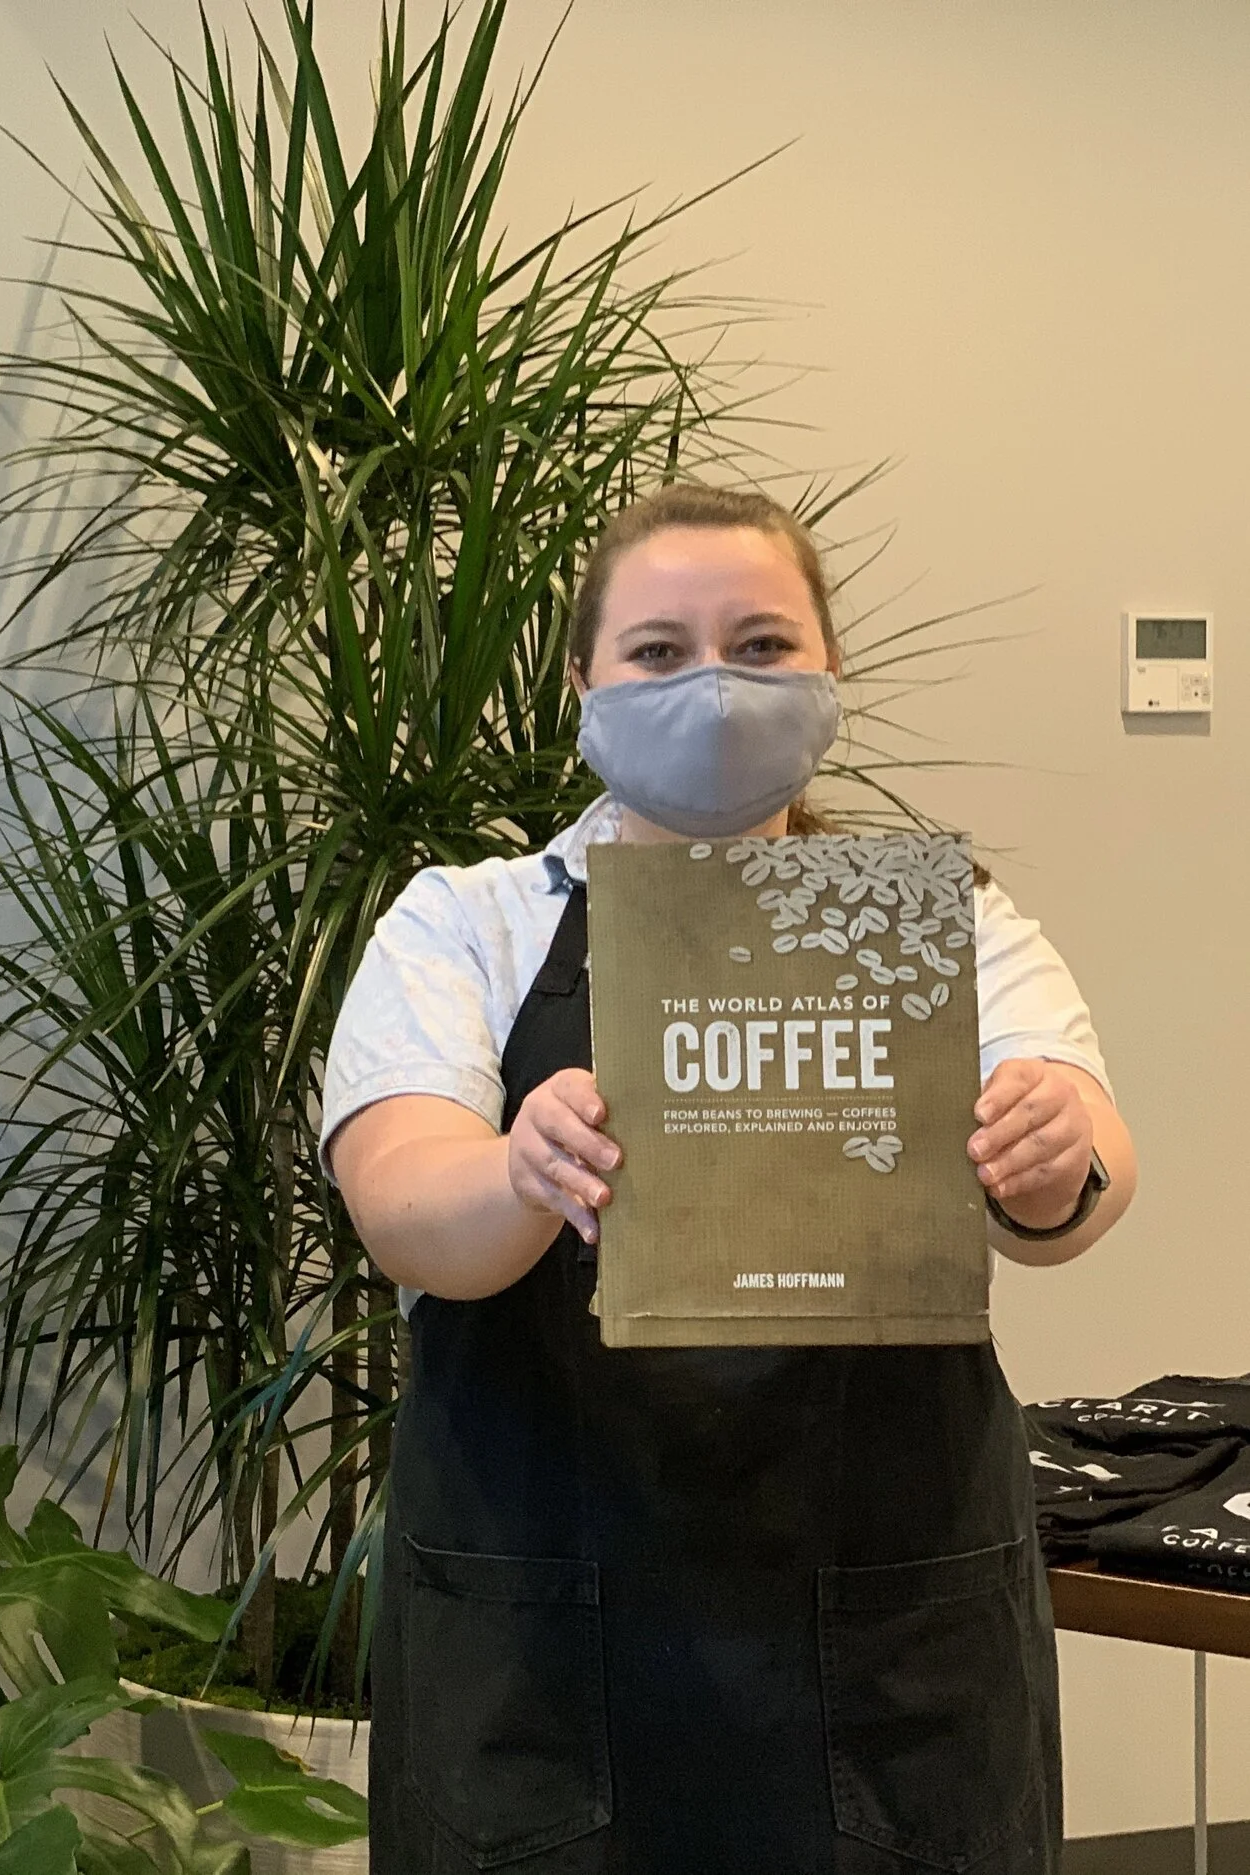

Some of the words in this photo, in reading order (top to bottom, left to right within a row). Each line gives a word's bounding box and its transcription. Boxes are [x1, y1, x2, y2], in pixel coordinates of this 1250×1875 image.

[661, 999, 700, 1013] THE
[708, 997, 783, 1012] WORLD
[791, 996, 854, 1012] ATLAS
[862, 995, 891, 1010] OF
[663, 1019, 895, 1093] COFFEE
[663, 1110, 699, 1120] FROM
[702, 1109, 743, 1120] BEANS
[745, 1108, 763, 1119] TO
[766, 1108, 823, 1119] BREWING
[842, 1107, 897, 1118] COFFEES
[664, 1122, 731, 1134] EXPLORED,
[735, 1121, 803, 1133] EXPLAINED
[807, 1121, 835, 1132] AND
[839, 1120, 897, 1132] ENJOYED
[733, 1273, 774, 1289] JAMES
[777, 1272, 845, 1288] HOFFMANN
[1038, 1399, 1224, 1425] CLARIT
